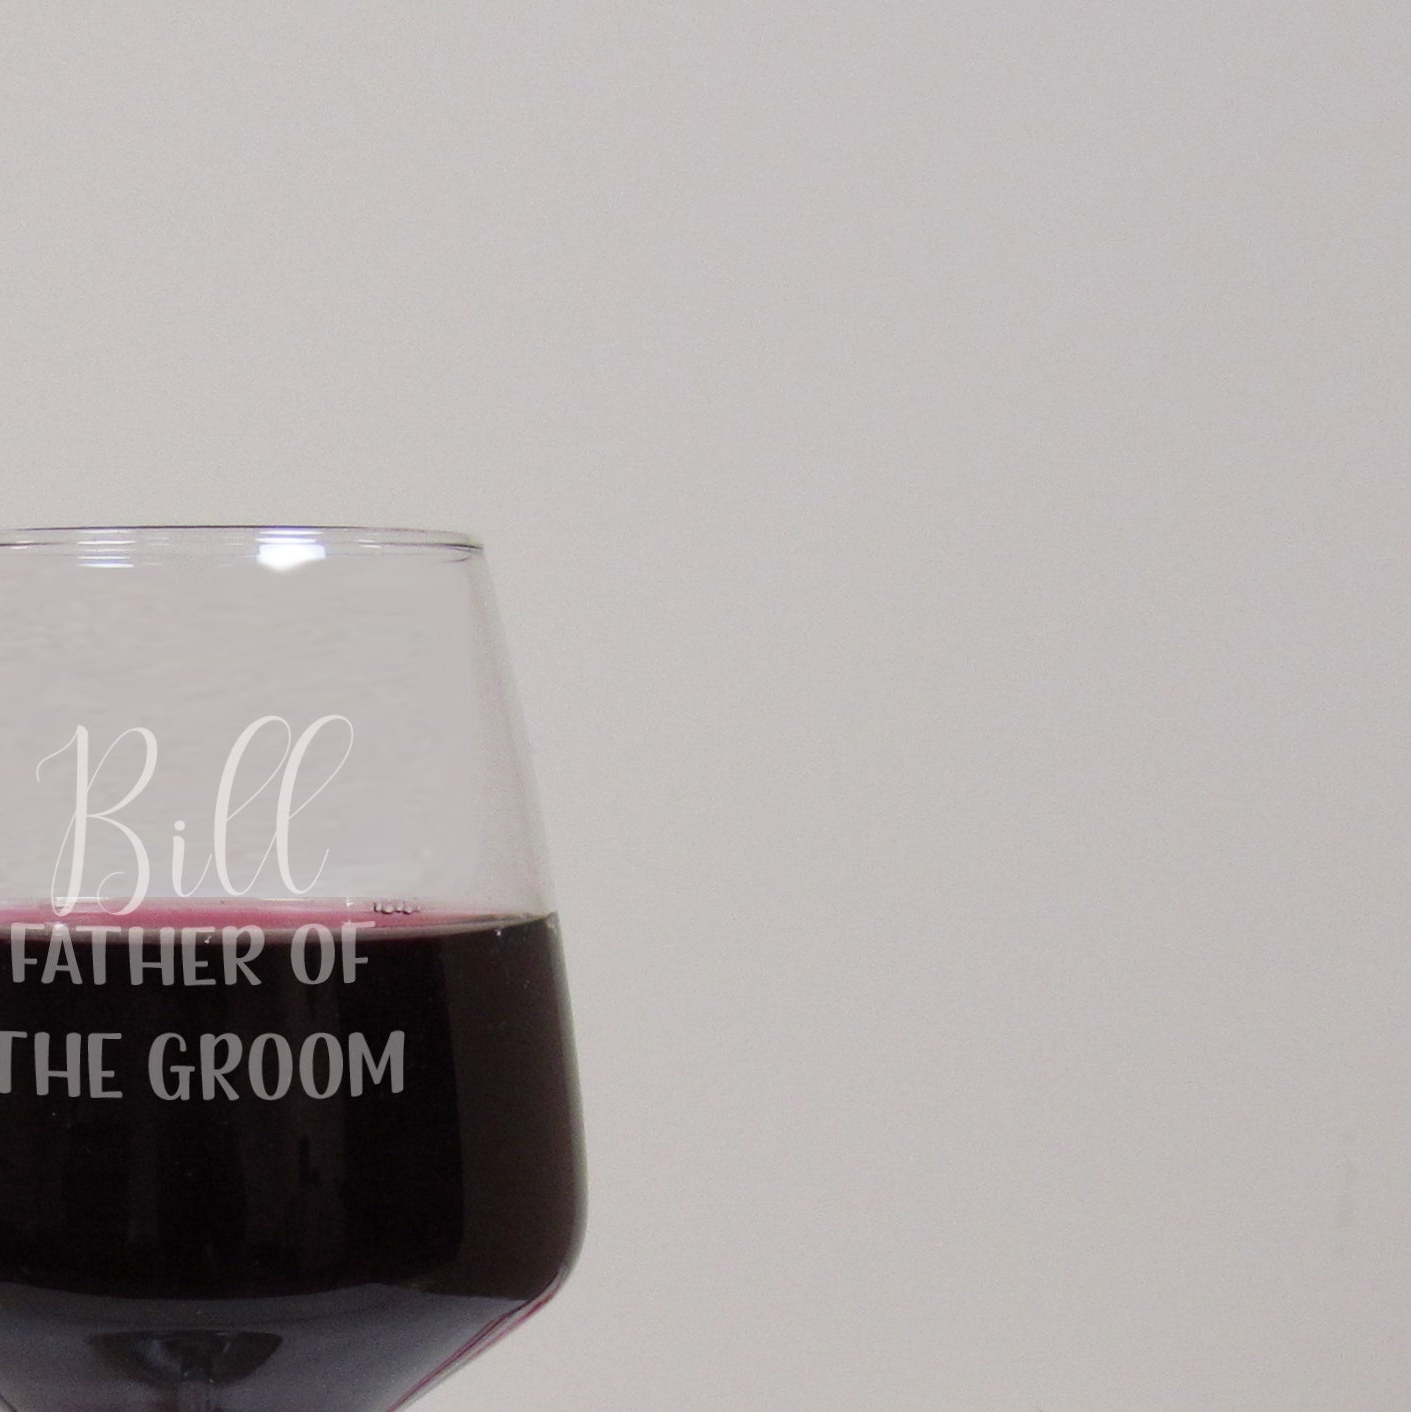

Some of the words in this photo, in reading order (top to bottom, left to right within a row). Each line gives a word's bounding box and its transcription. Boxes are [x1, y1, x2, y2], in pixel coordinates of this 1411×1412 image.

[36, 714, 354, 917] Bill
[10, 921, 266, 986] FATHER
[290, 920, 376, 985] OF
[148, 1030, 405, 1101] GROOM
